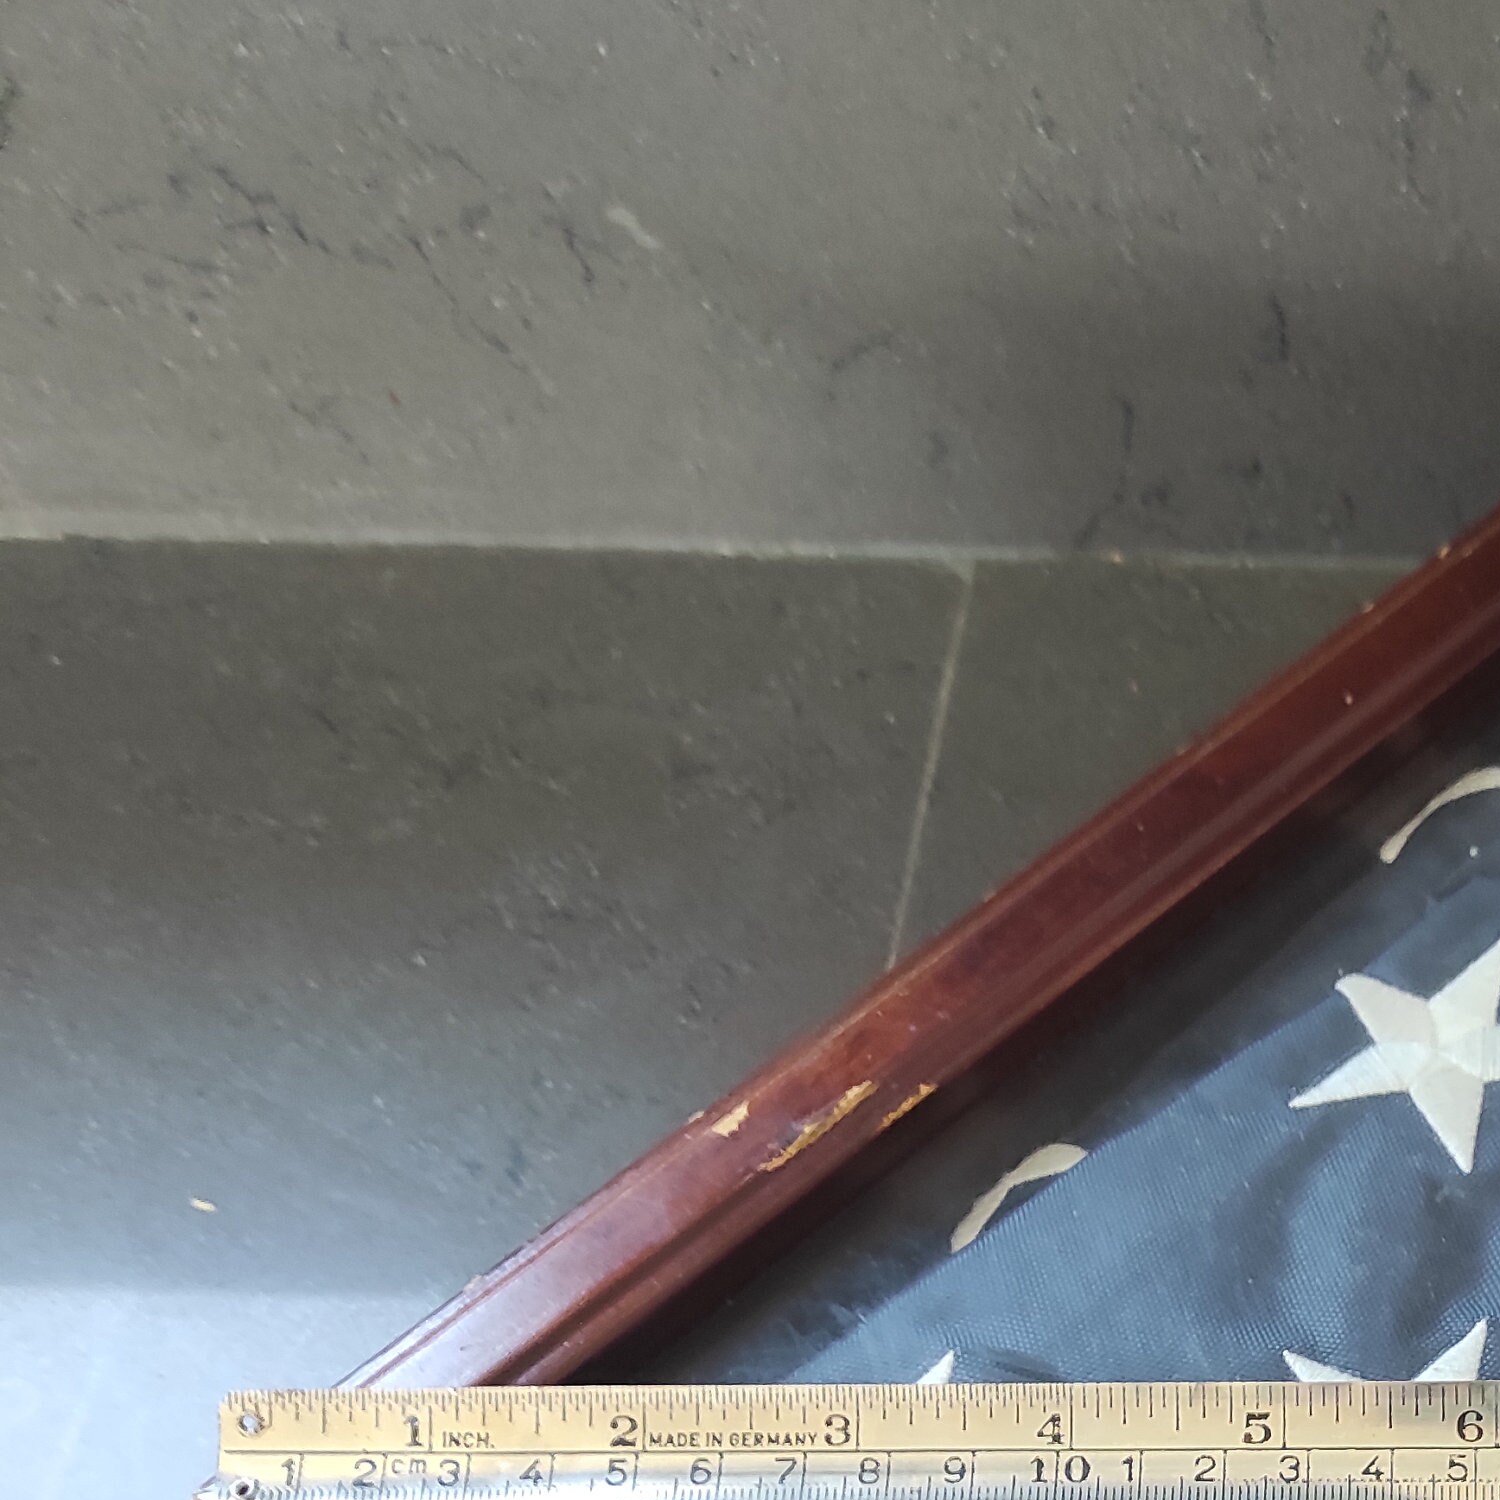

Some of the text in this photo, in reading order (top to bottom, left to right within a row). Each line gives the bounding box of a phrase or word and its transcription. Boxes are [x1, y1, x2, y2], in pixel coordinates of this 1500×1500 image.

[404, 1416, 421, 1448] 1
[609, 1415, 639, 1448] 2
[649, 1431, 700, 1448] MADE
[704, 1432, 723, 1448] IN
[729, 1430, 817, 1448] GERMANY
[823, 1413, 851, 1446] 3
[1036, 1412, 1065, 1445] 4
[1242, 1412, 1272, 1445] 5
[1456, 1410, 1484, 1442] 6
[281, 1458, 296, 1486] 1
[353, 1458, 378, 1488] 2
[391, 1456, 428, 1475] cm
[437, 1458, 461, 1488] 3
[519, 1459, 542, 1487] 4
[605, 1458, 628, 1487] 5
[688, 1458, 714, 1486] 6
[774, 1457, 798, 1486] 7
[858, 1457, 881, 1486] 8
[943, 1456, 967, 1485] 9
[1122, 1456, 1136, 1484] 1
[1195, 1455, 1218, 1483] 2
[1278, 1455, 1301, 1484] 3
[1361, 1455, 1384, 1480] 4
[1448, 1454, 1470, 1481] 5
